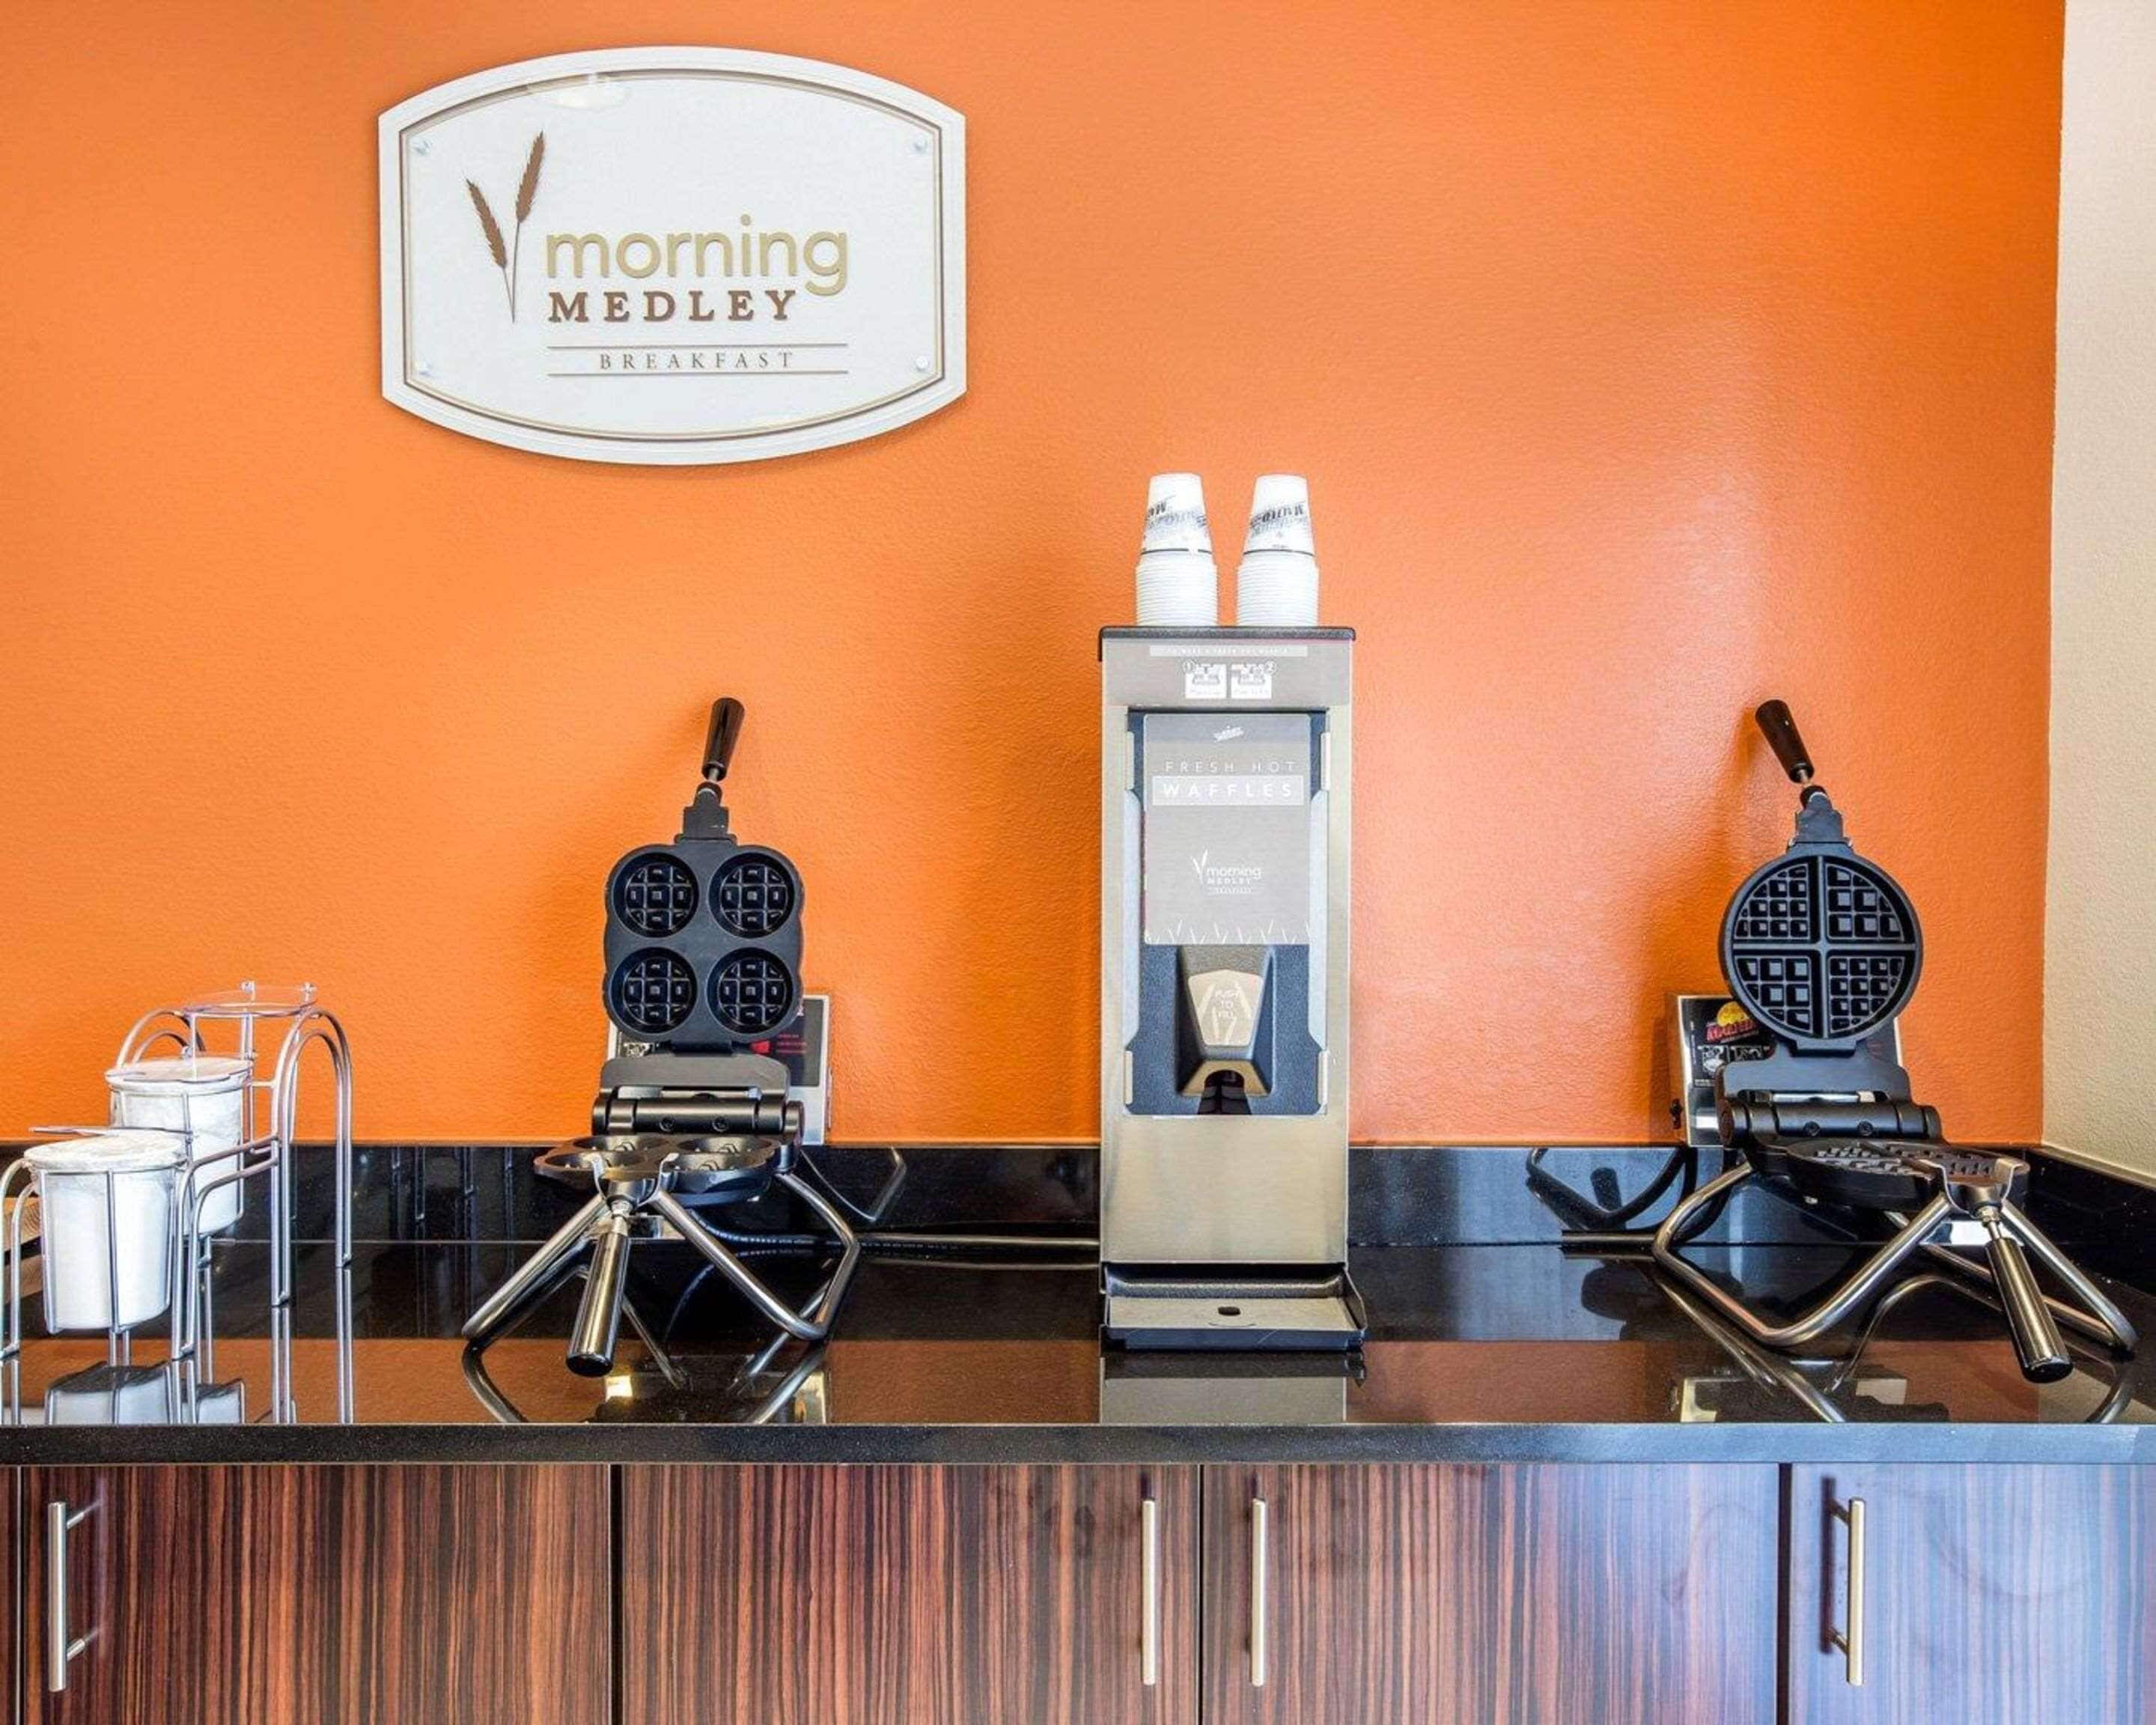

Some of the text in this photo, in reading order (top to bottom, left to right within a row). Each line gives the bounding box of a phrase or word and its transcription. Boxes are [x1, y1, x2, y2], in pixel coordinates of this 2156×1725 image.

[546, 214, 849, 295] morning
[549, 290, 797, 323] MEDLEY
[600, 351, 793, 370] BREAKFAST
[1165, 761, 1296, 773] FRESH HOT
[1163, 782, 1294, 798] WAFFLES
[1206, 864, 1262, 880] morning
